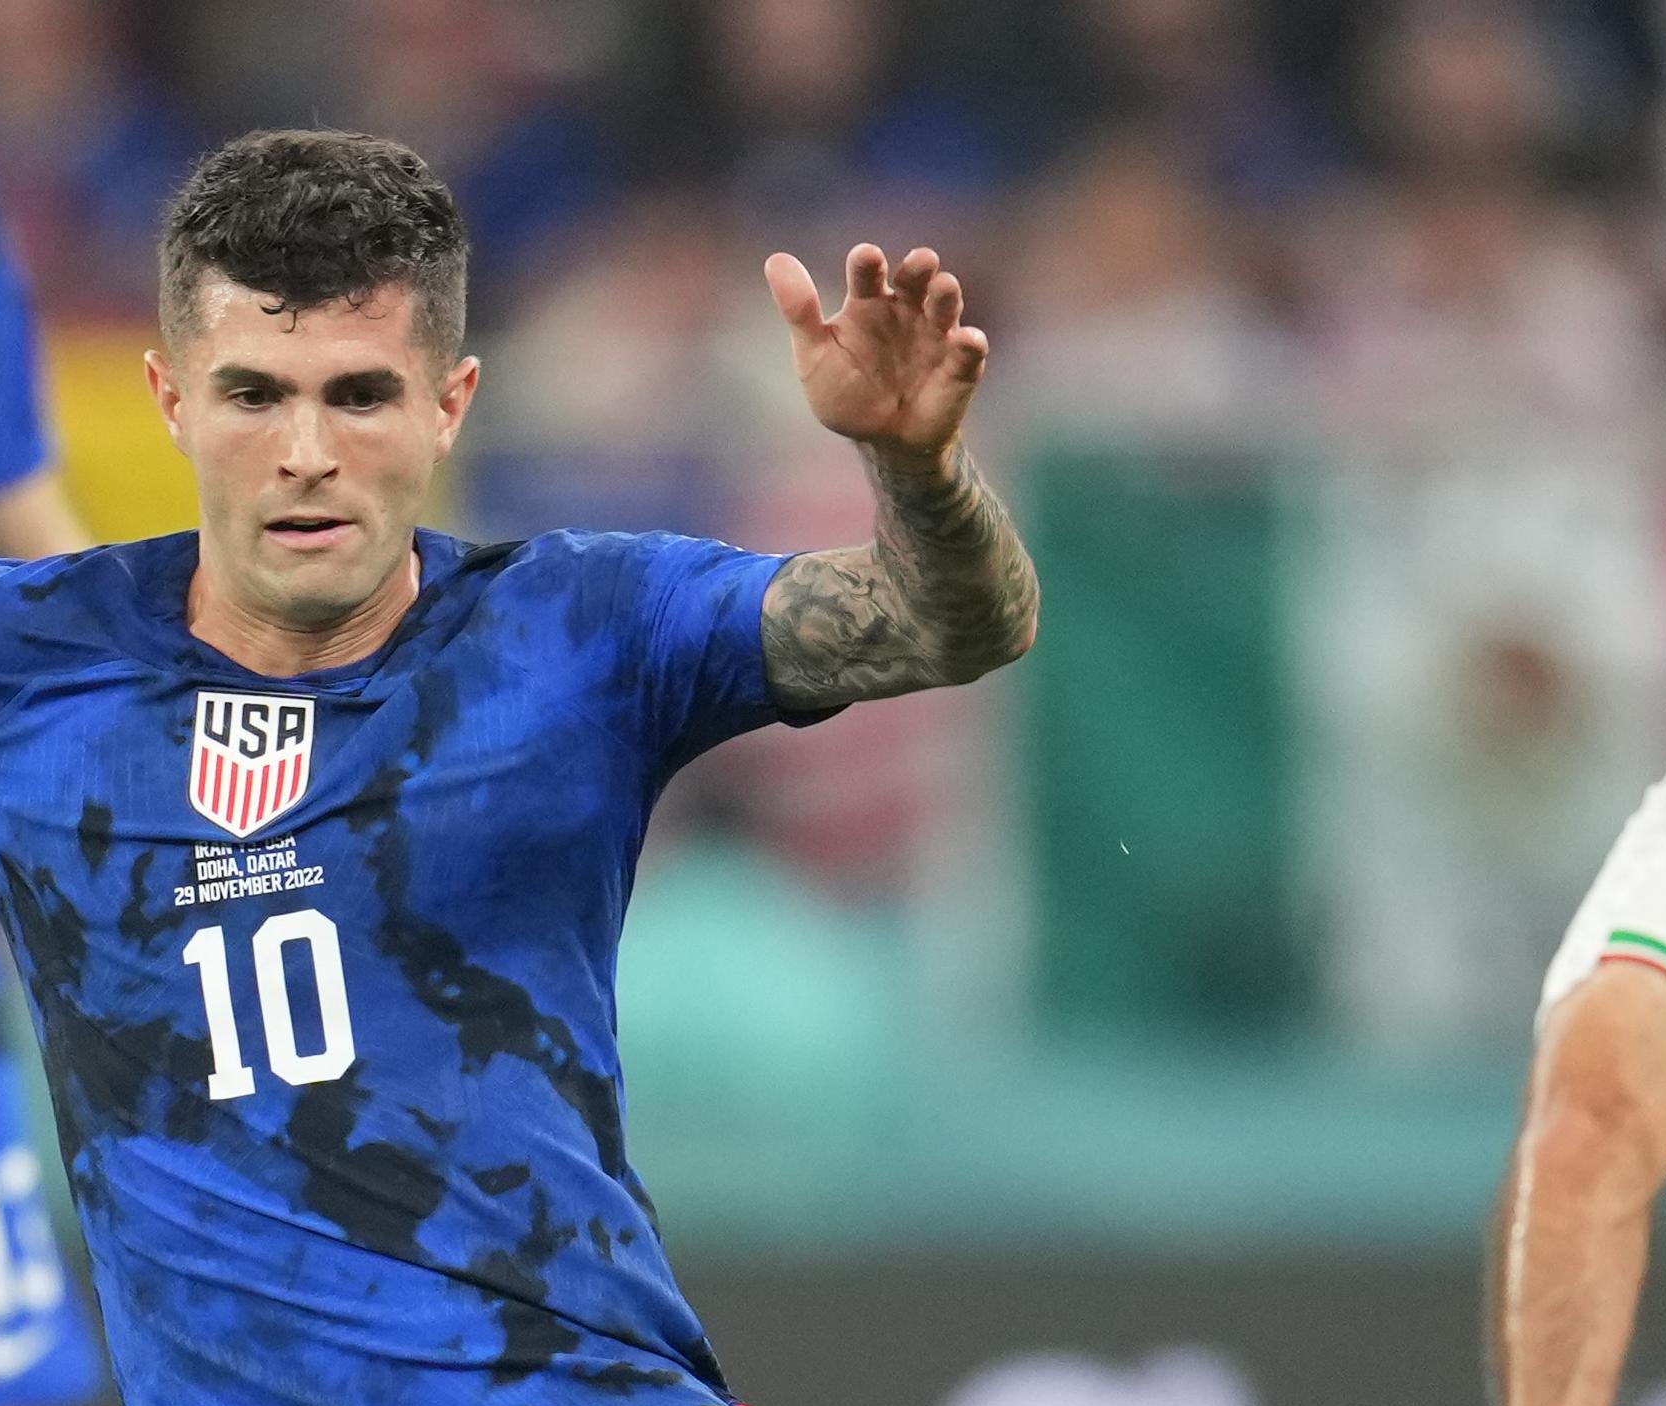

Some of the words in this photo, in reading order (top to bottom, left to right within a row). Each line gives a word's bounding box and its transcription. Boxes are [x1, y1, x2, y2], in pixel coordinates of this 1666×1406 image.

[203, 699, 307, 760] USA
[174, 886, 196, 906] 29
[198, 873, 283, 904] NOVEMBER
[284, 865, 325, 890] 2022
[196, 857, 244, 881] DOHA,
[246, 850, 297, 874] QATAR
[182, 907, 358, 1101] 10
